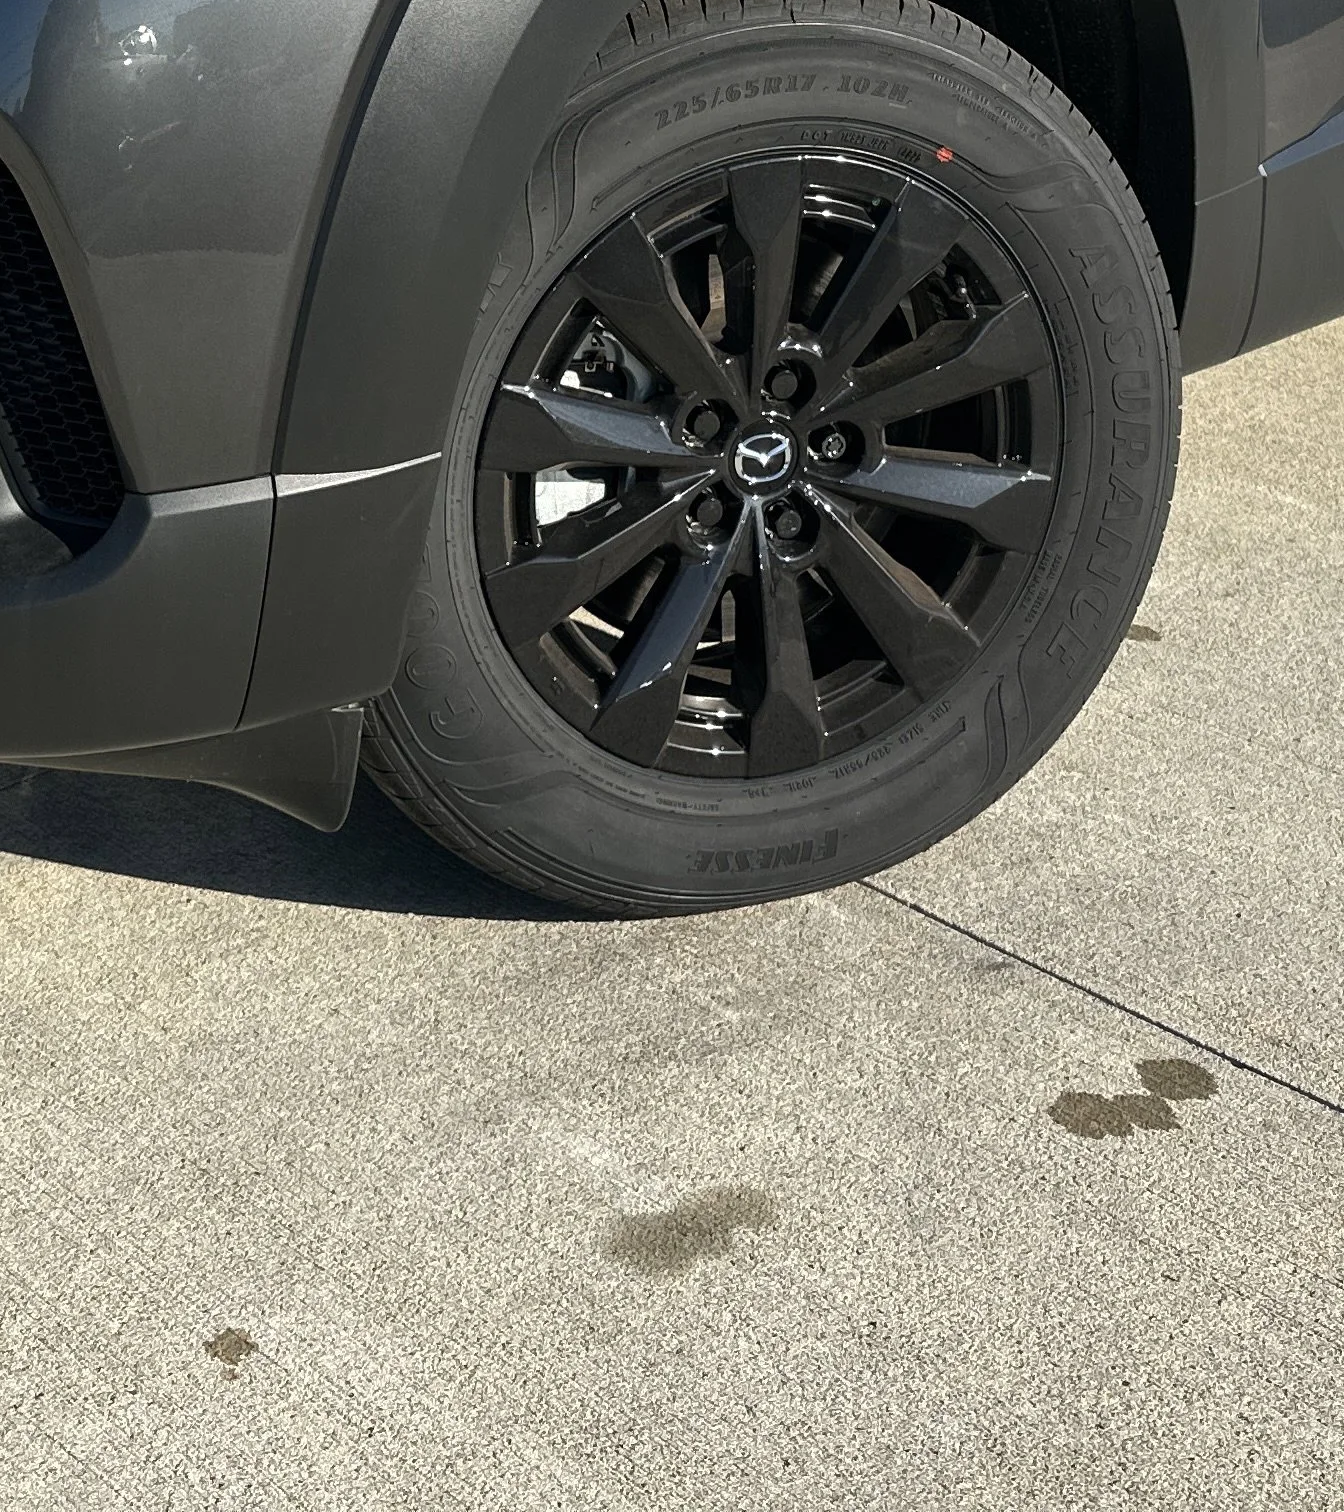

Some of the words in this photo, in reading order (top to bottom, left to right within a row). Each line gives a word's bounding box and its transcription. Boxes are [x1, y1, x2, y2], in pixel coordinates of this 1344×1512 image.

[655, 74, 816, 130] 225/65R17
[1045, 244, 1152, 680] ASSURANCE
[687, 828, 839, 873] FINESSE
